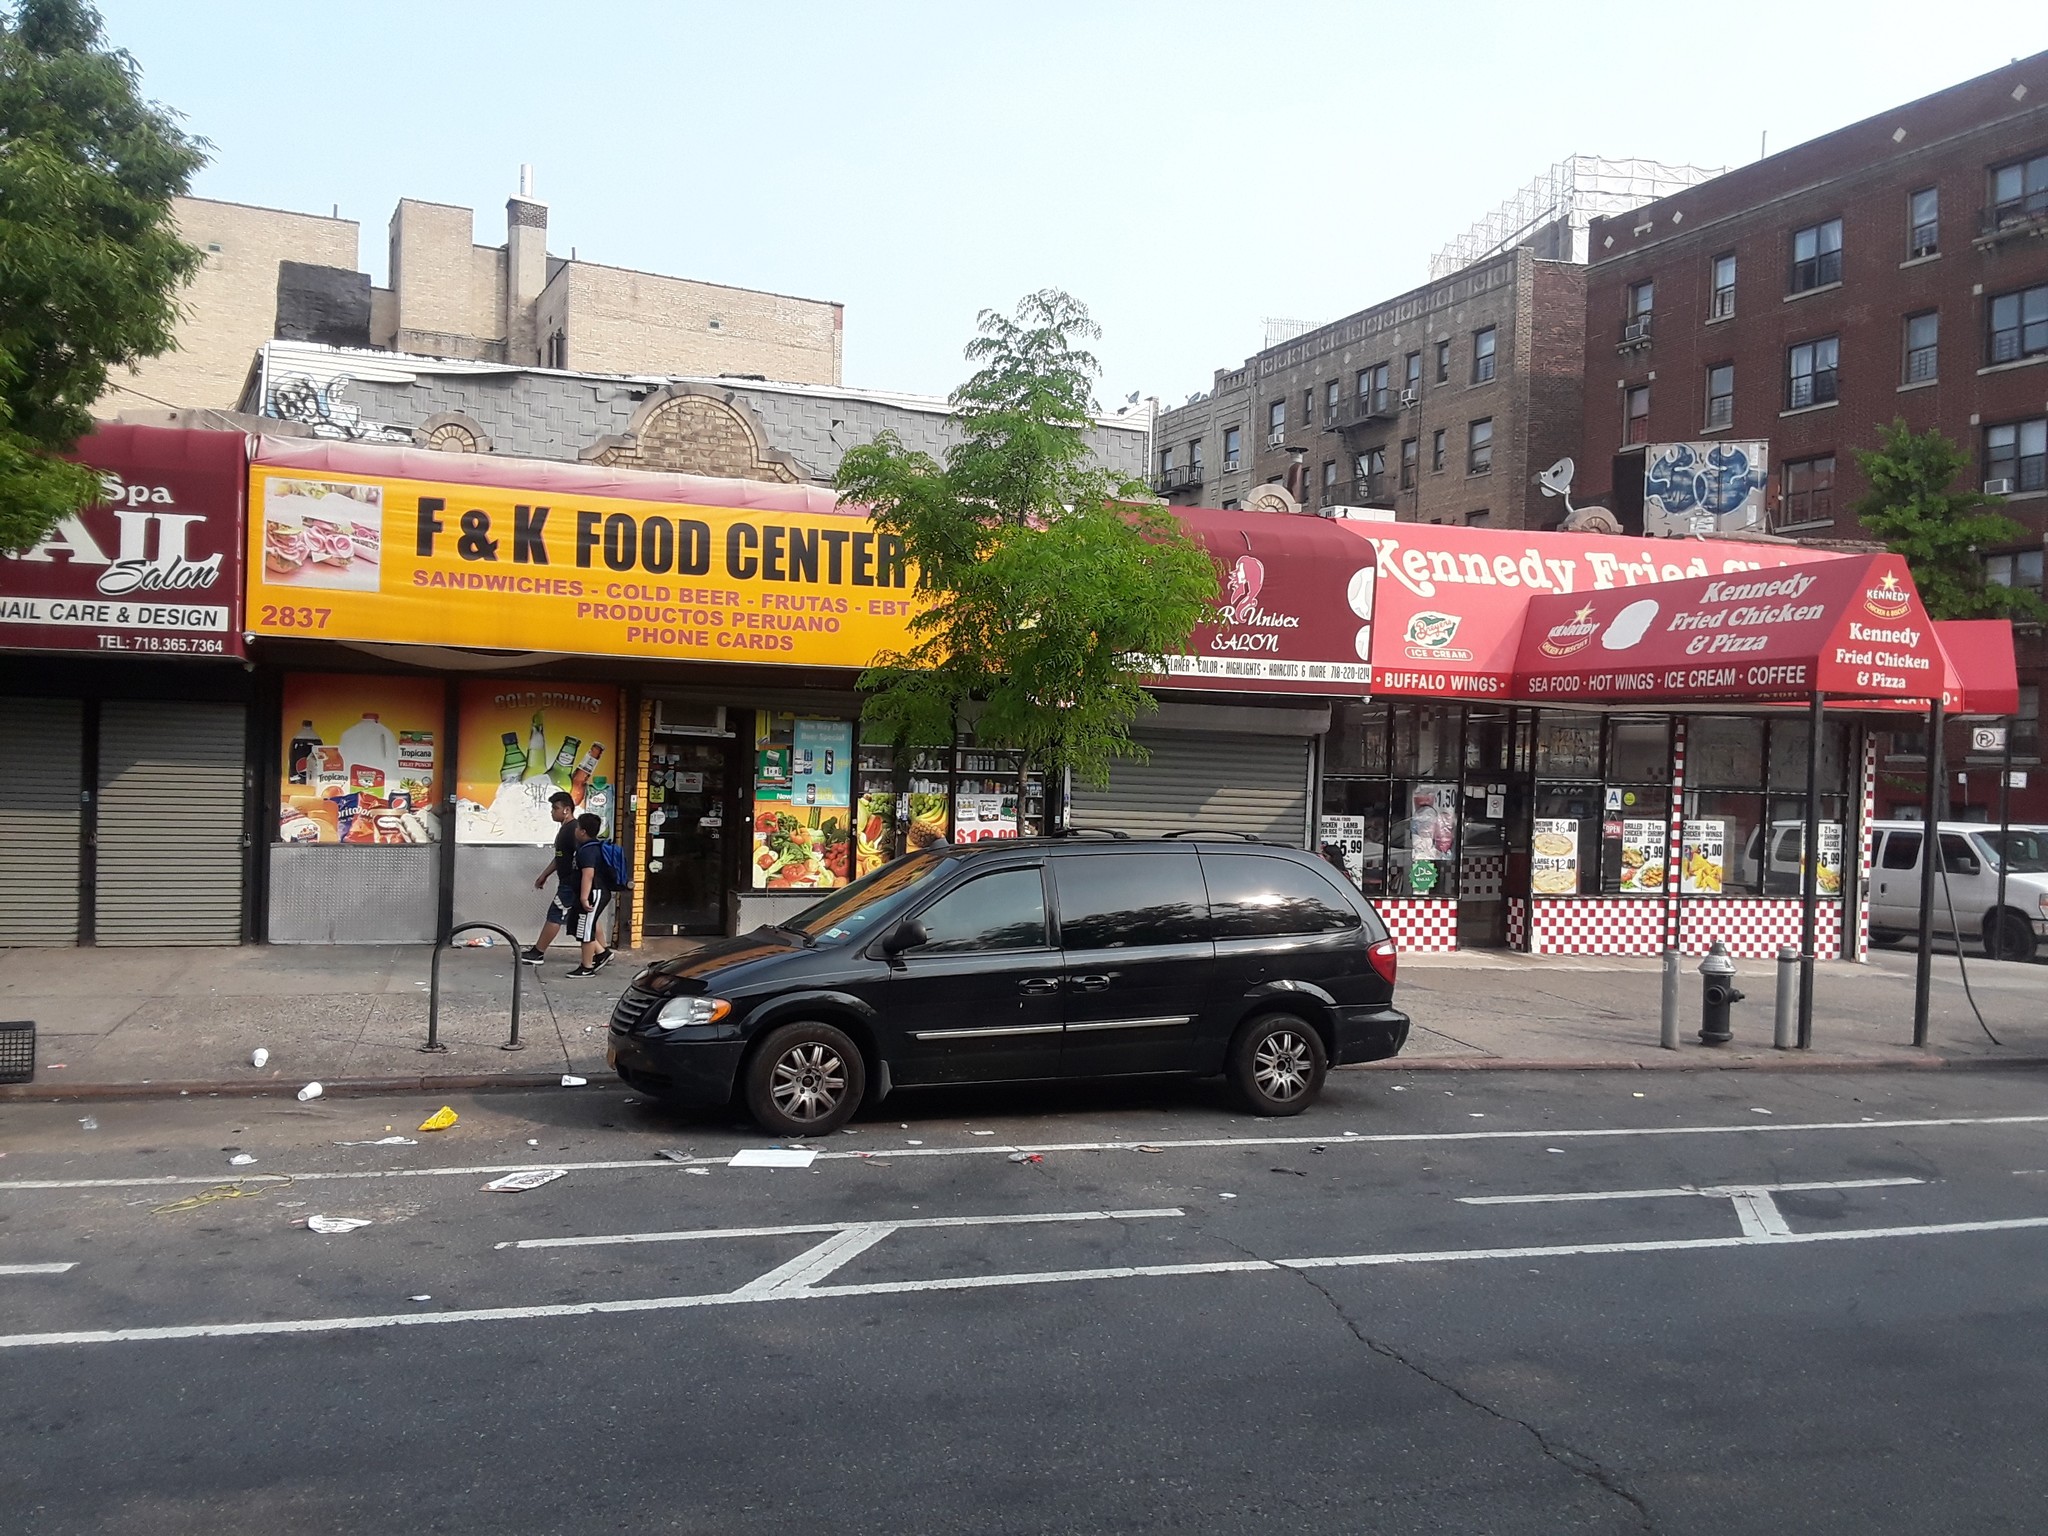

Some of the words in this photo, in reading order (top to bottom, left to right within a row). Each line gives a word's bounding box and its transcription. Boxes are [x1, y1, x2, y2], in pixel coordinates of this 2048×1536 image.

[100, 475, 175, 506] Spa
[0, 511, 223, 565] AIL
[416, 496, 446, 557] F
[458, 509, 499, 562] &
[513, 504, 551, 566] K
[576, 511, 711, 577] FOOD
[726, 522, 907, 588] CENTER
[97, 555, 218, 595] Salon
[1366, 538, 1578, 597] Kennedy
[413, 569, 583, 597] SANDWICHES
[606, 583, 671, 602] COLD
[679, 588, 740, 606] BEER
[761, 593, 848, 614] FRUTAS
[868, 600, 910, 616] EBT
[1699, 573, 1817, 604] Kennedy
[1866, 589, 1910, 602] KENNEDY
[50, 603, 110, 622] CARE
[116, 607, 130, 623] &
[138, 608, 218, 627] DESIGN
[260, 604, 332, 630] 2837
[577, 602, 724, 626] PRODUCTOS
[731, 612, 841, 633] PERUANO
[1243, 604, 1299, 628] Unisex
[1667, 609, 1729, 631] Fried
[1727, 603, 1825, 627] Chicken
[1866, 602, 1886, 617] CHICKEN
[1890, 606, 1908, 617] BISCUIT
[627, 626, 709, 647] PHONE
[717, 632, 794, 651] CARDS
[1415, 619, 1453, 641] Breyers
[1548, 622, 1600, 638] KENNEDY
[1849, 622, 1920, 648] Kennedy
[97, 635, 130, 649] TEL:
[134, 637, 223, 652] 718.365.7364
[1211, 633, 1279, 652] SALON
[1685, 635, 1710, 655] &
[1706, 634, 1769, 653] Pizza
[1411, 649, 1428, 658] ICE
[1433, 650, 1468, 659] CREAM
[1836, 648, 1872, 665] Fried
[1875, 652, 1930, 669] Chicken
[1197, 660, 1218, 674] COLOR
[1225, 662, 1261, 675] HIGHLIGHTS
[1268, 663, 1298, 677] HAIRCUTS
[1309, 665, 1326, 678] MORE
[1529, 677, 1548, 693] SEA
[1550, 676, 1580, 692] FOOD
[1588, 674, 1611, 691] HOT
[1610, 673, 1654, 690] WINGS
[1664, 671, 1686, 688] ICE
[1688, 668, 1736, 688] CREAM
[1747, 665, 1806, 686] COFFEE
[1857, 671, 1869, 686] &
[1872, 672, 1906, 688] Pizza
[1384, 672, 1446, 690] BUFFALO
[1451, 677, 1498, 692] WINGS
[400, 748, 431, 759] Tropicana
[318, 772, 348, 782] Tropicana
[1608, 791, 1619, 804] A
[1605, 825, 1621, 834] OPEN
[1639, 846, 1664, 862] $5.99
[1551, 859, 1576, 872] $12.00
